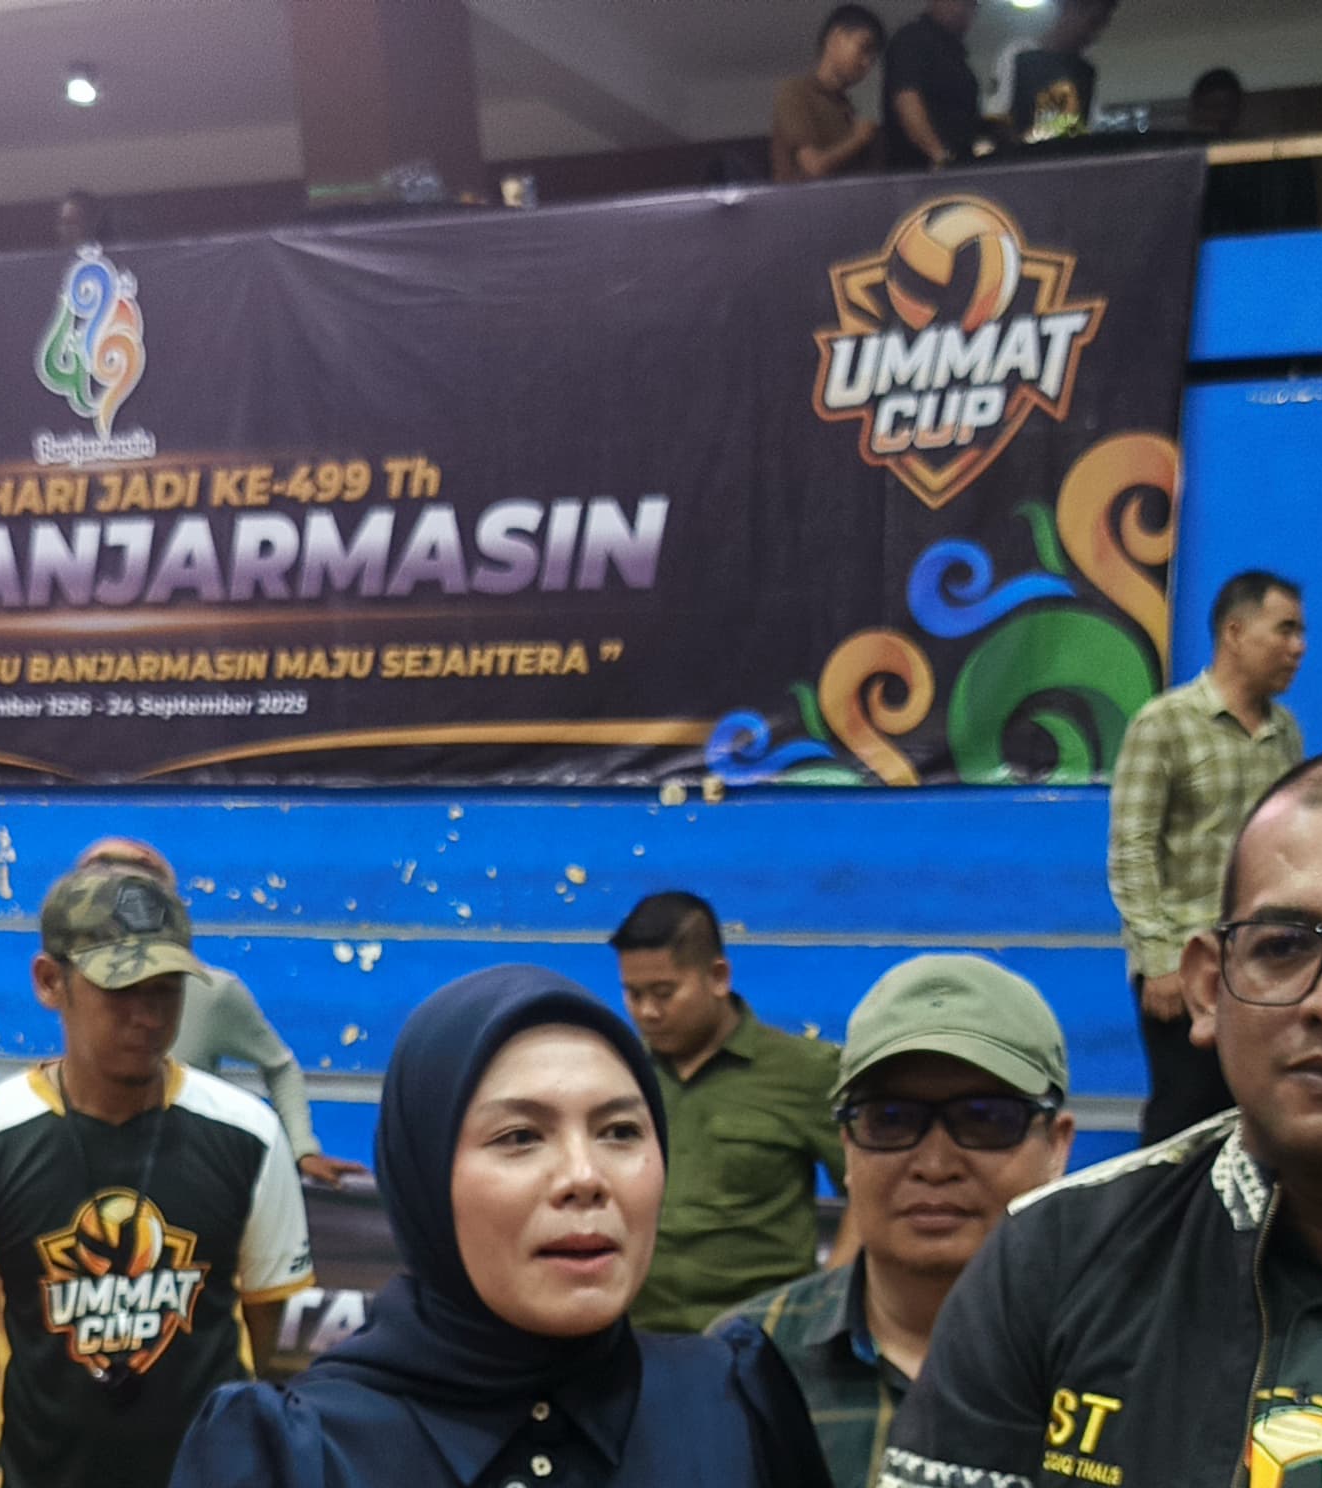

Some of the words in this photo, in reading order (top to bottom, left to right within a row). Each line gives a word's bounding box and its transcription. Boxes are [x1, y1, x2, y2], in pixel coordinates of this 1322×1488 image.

[825, 312, 1089, 408] UMMAT
[872, 385, 1006, 454] CUP
[95, 468, 202, 512] JADI
[211, 459, 373, 507] KE-499
[383, 456, 442, 500] Th
[26, 649, 269, 685] BANJARMASIN
[275, 647, 375, 681] MAJU
[380, 641, 590, 679] SEJAHTERA
[137, 692, 253, 718] September
[50, 1268, 202, 1326] UMMAT
[78, 1313, 161, 1355] CUP
[1045, 1387, 1123, 1455] ST
